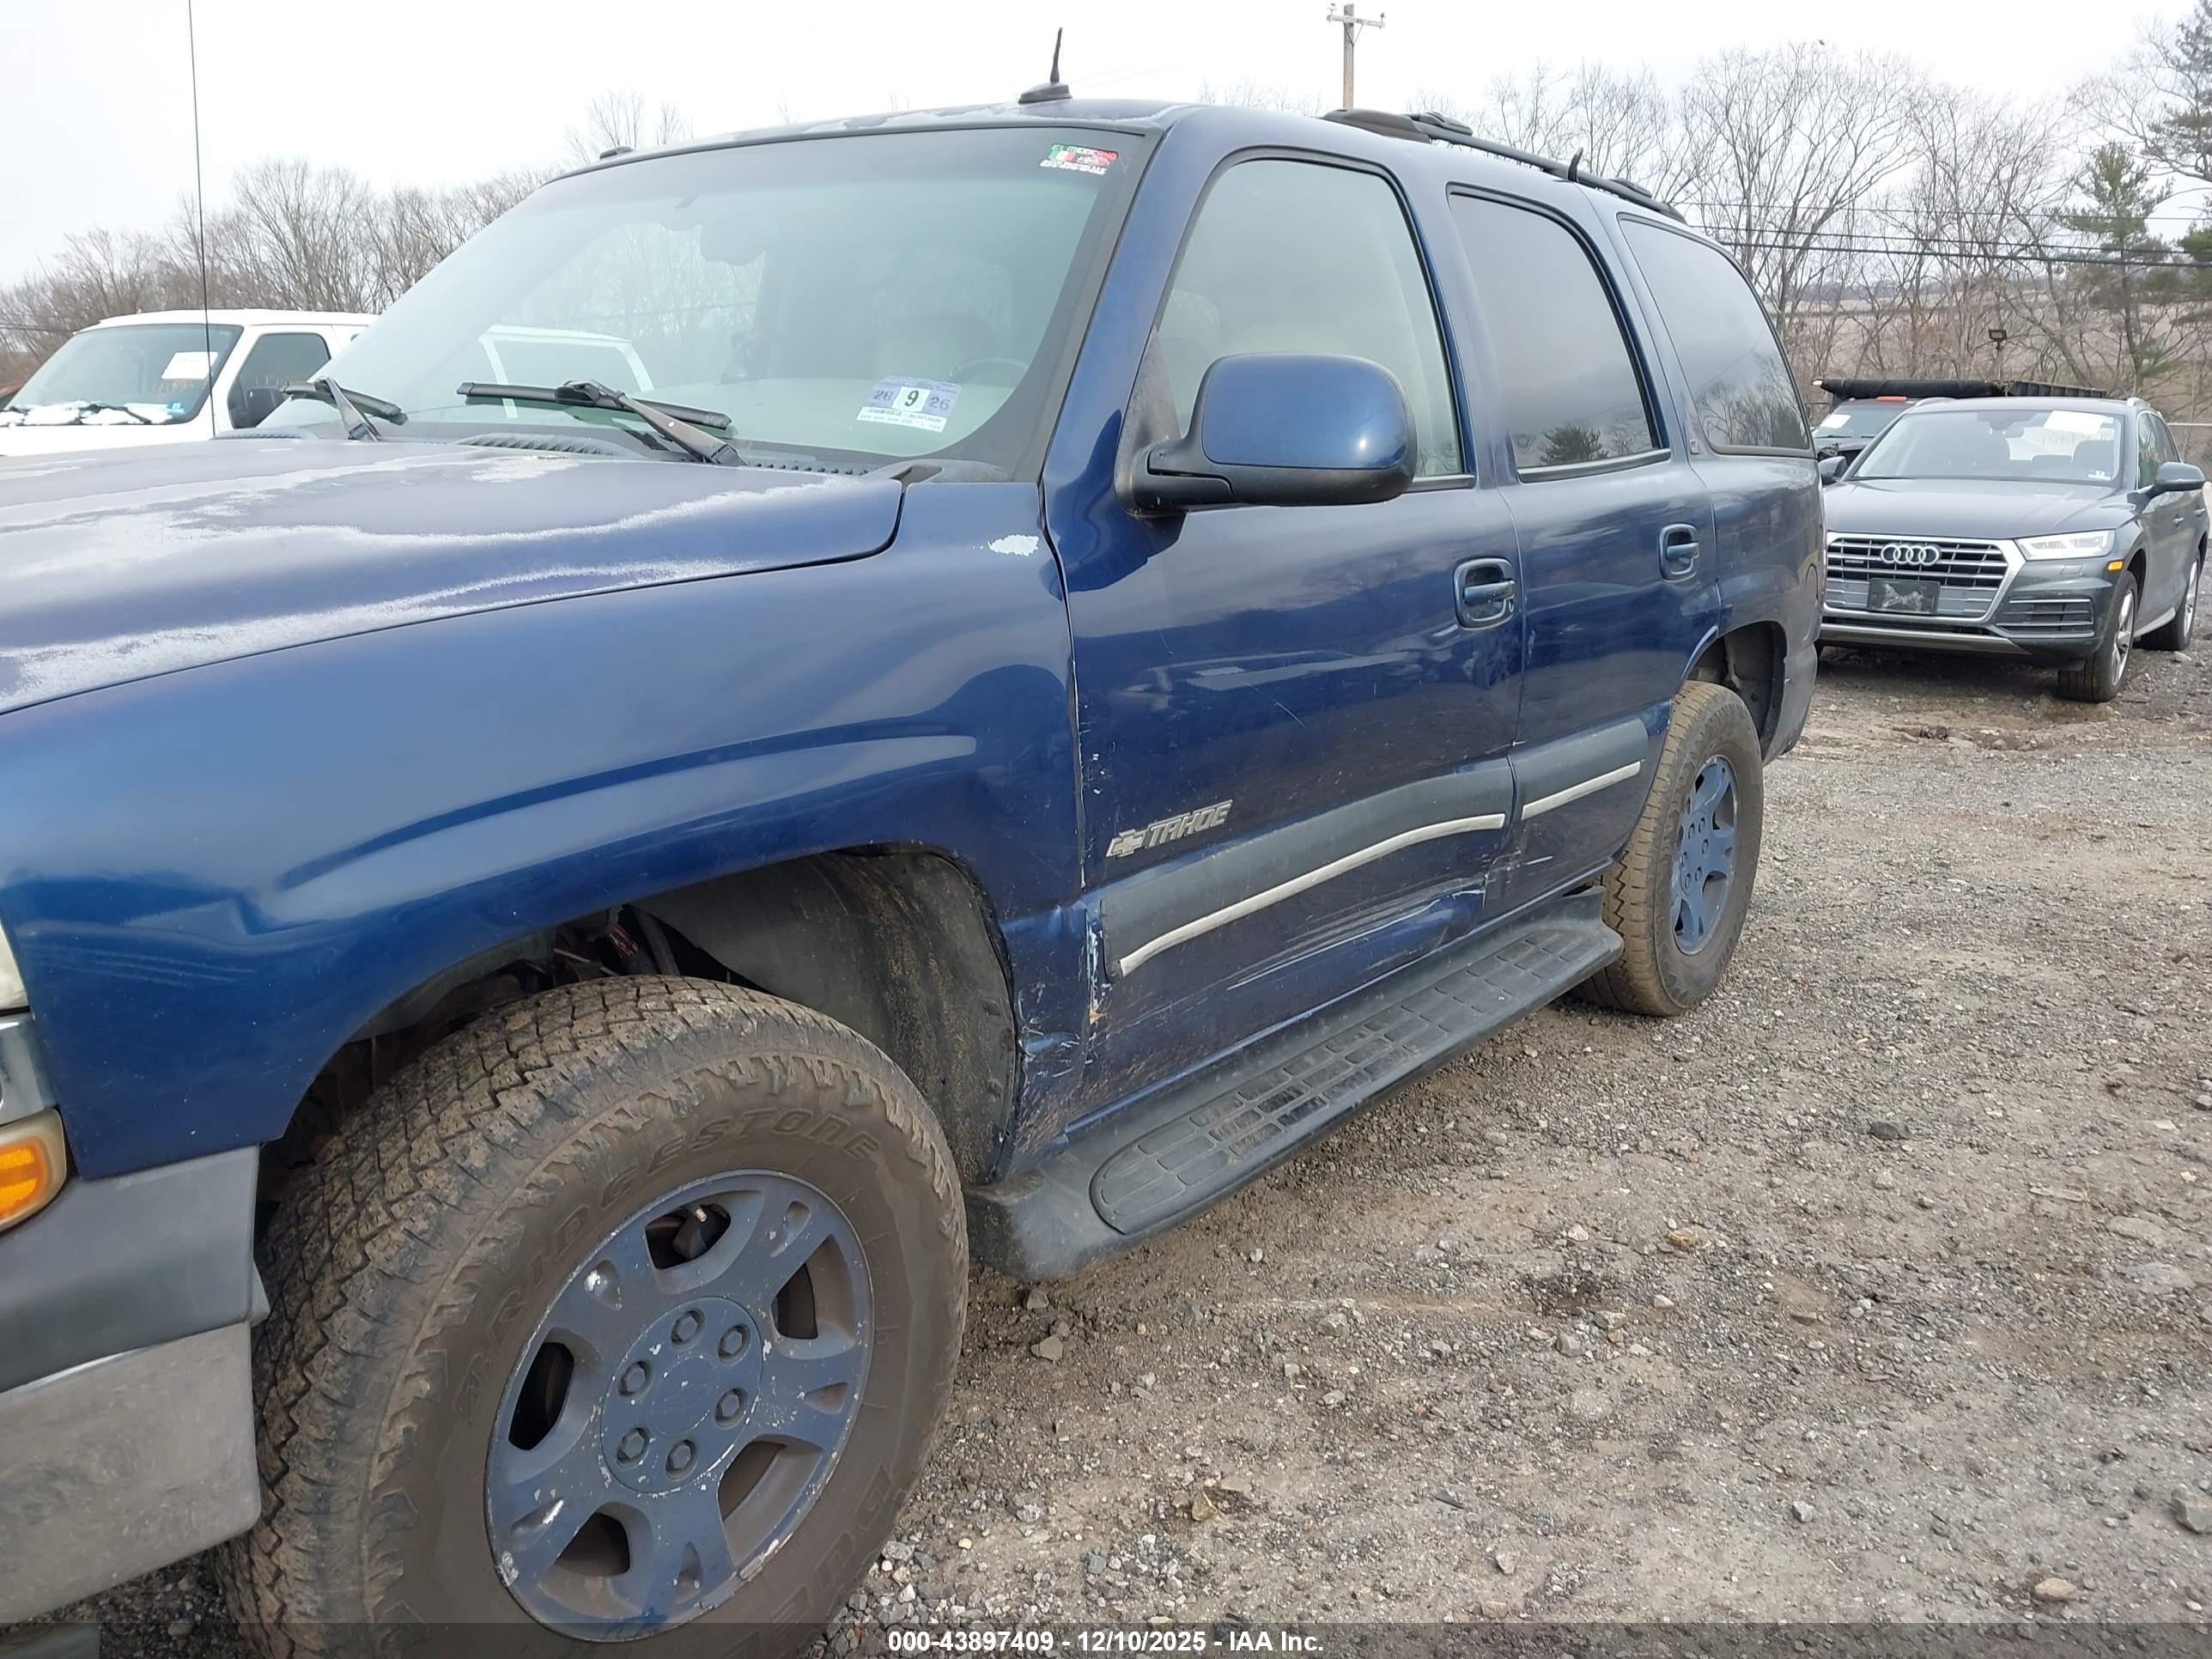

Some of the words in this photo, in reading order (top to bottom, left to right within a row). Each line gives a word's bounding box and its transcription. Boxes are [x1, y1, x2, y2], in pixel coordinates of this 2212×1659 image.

[904, 389, 920, 407] 9
[927, 396, 951, 410] 26
[1148, 800, 1233, 848] TAHOE
[453, 1106, 883, 1422] BRIDGESTONE
